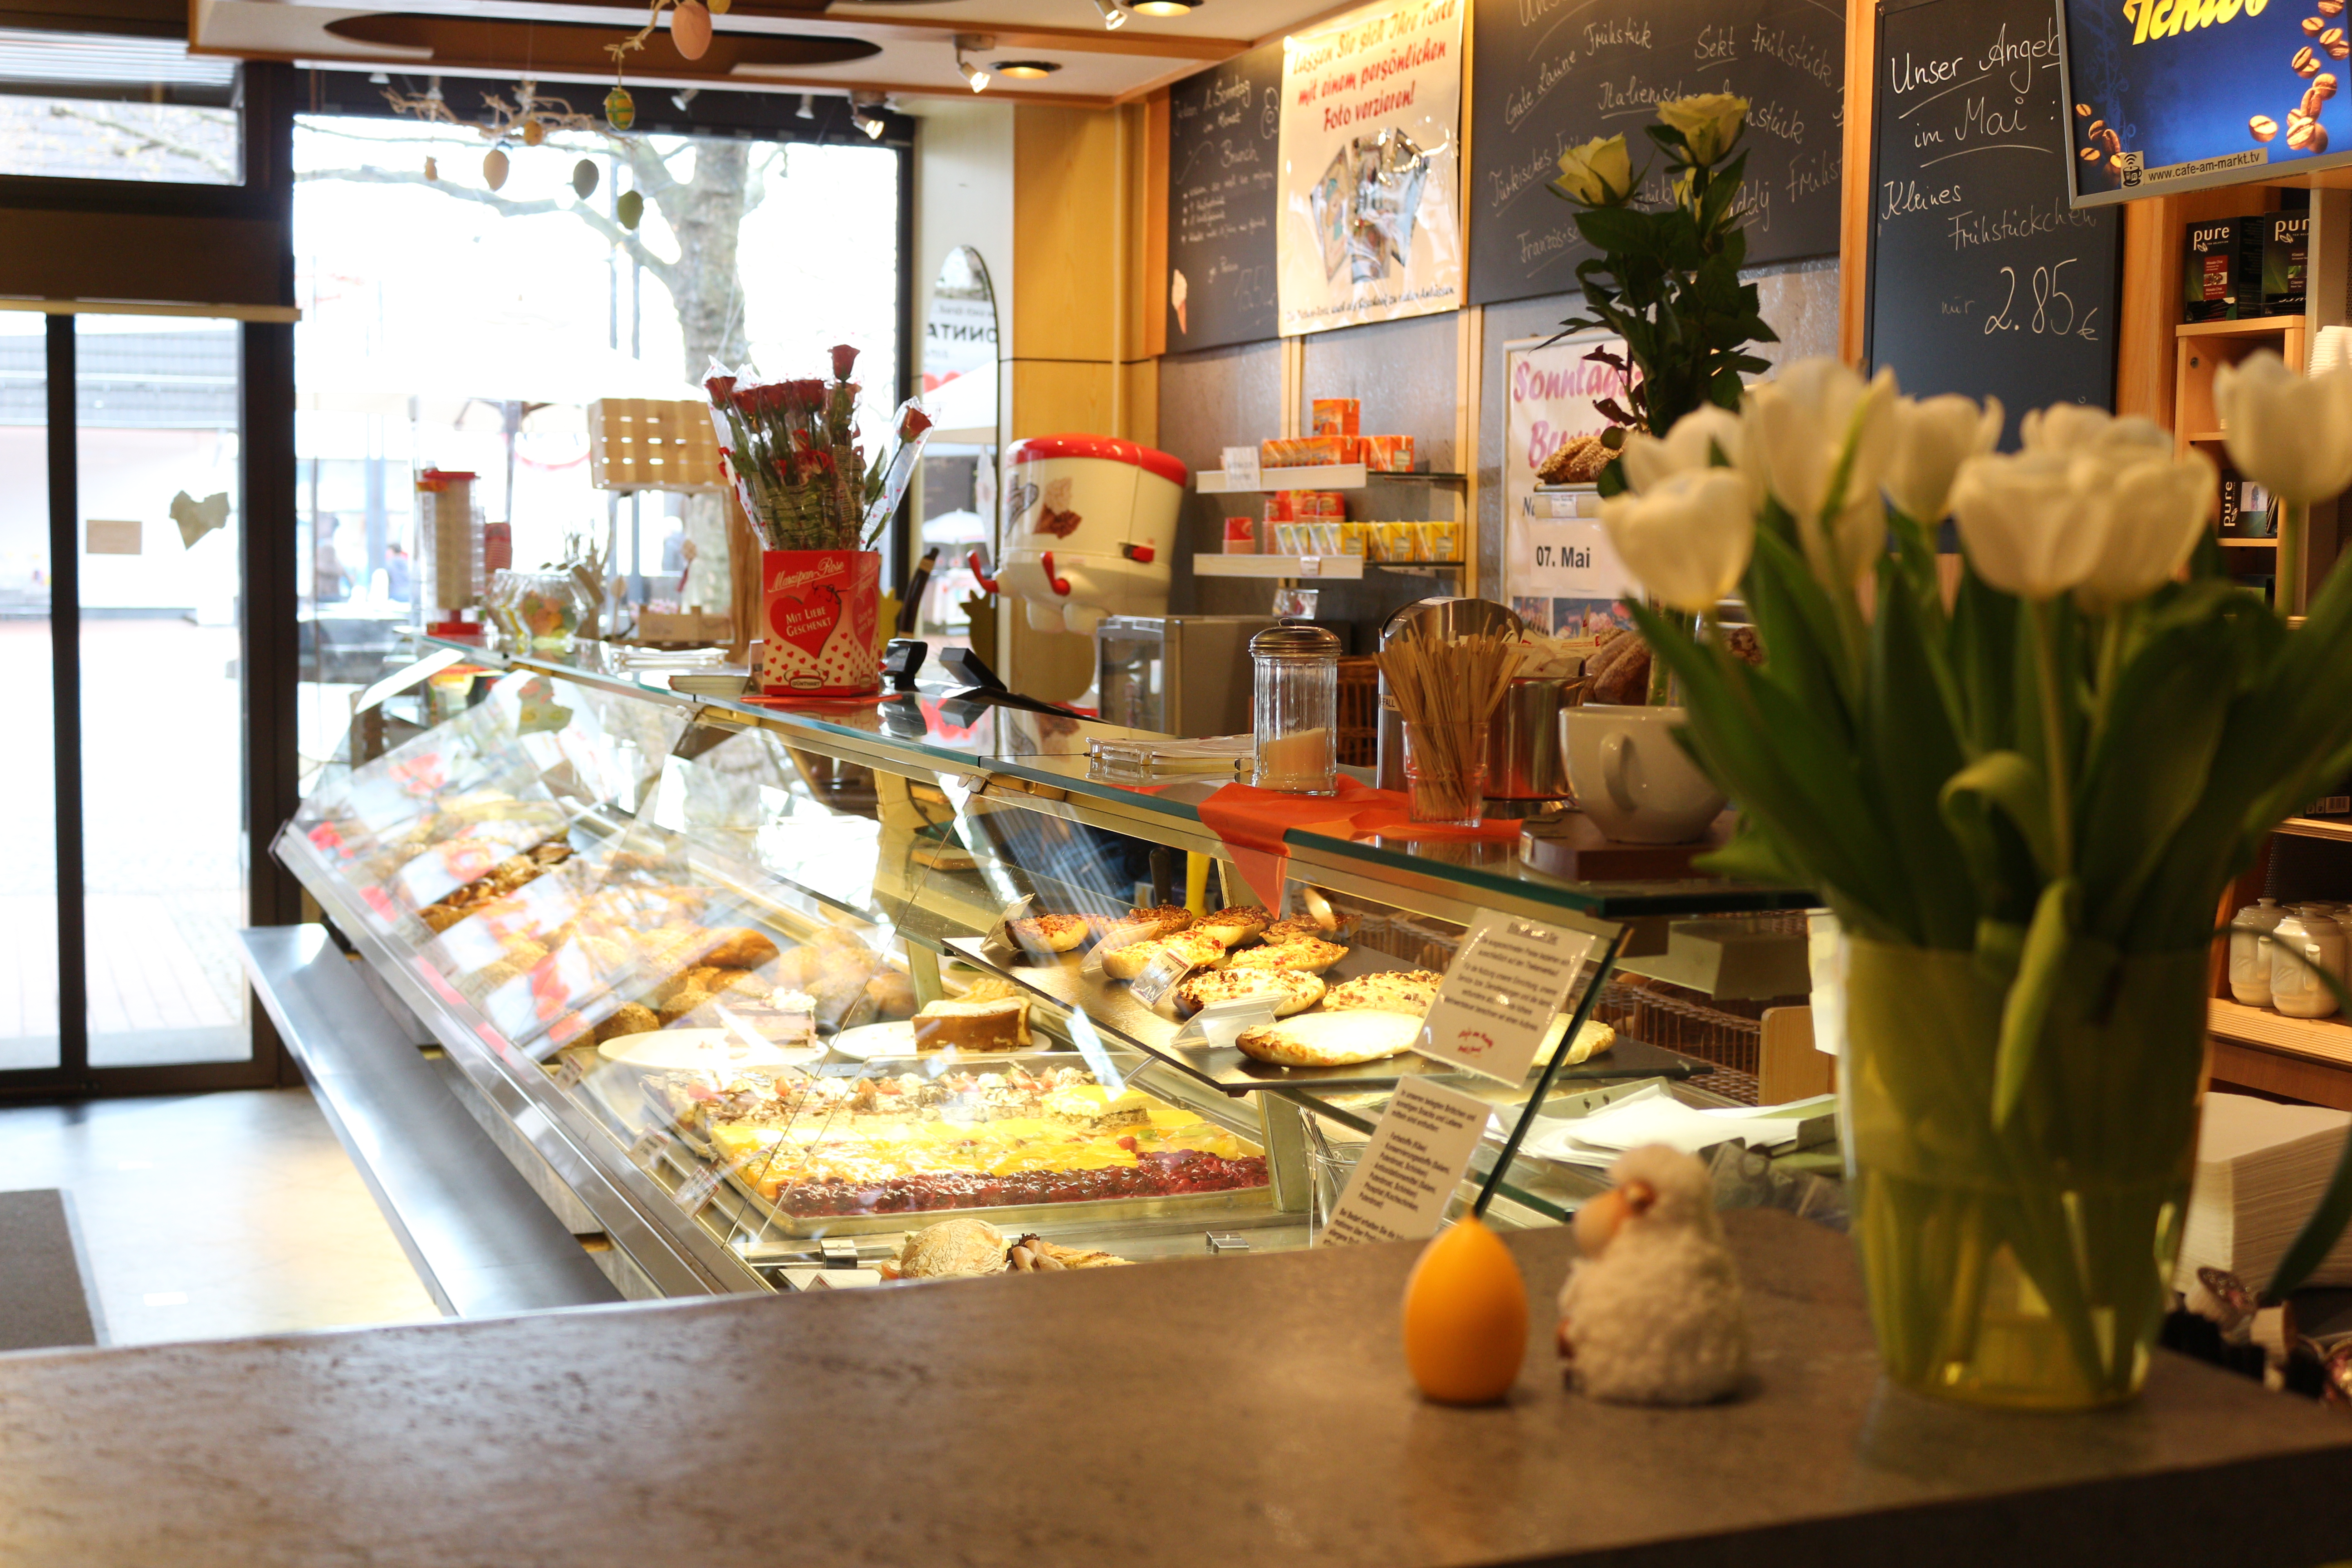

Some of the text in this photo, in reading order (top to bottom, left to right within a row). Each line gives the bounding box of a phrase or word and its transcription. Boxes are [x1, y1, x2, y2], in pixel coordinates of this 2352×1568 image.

[1338, 32, 1356, 58] Sie
[1695, 23, 1832, 88] Sekt Frühstück
[1321, 73, 1356, 98] einem
[1361, 37, 1446, 91] persönlichen
[1891, 53, 1963, 93] Unser
[1324, 79, 1416, 132] Foto verzieren!
[1915, 123, 1945, 148] im
[1955, 97, 2027, 141] Mai
[2148, 152, 2260, 181] www.cafe-am-markt.tv
[1882, 181, 1962, 220] Kleines
[1948, 197, 2097, 251] Frühstückchen
[2193, 227, 2230, 250] pure
[2224, 481, 2235, 526] pure
[1537, 546, 1590, 568] 07. Mai
